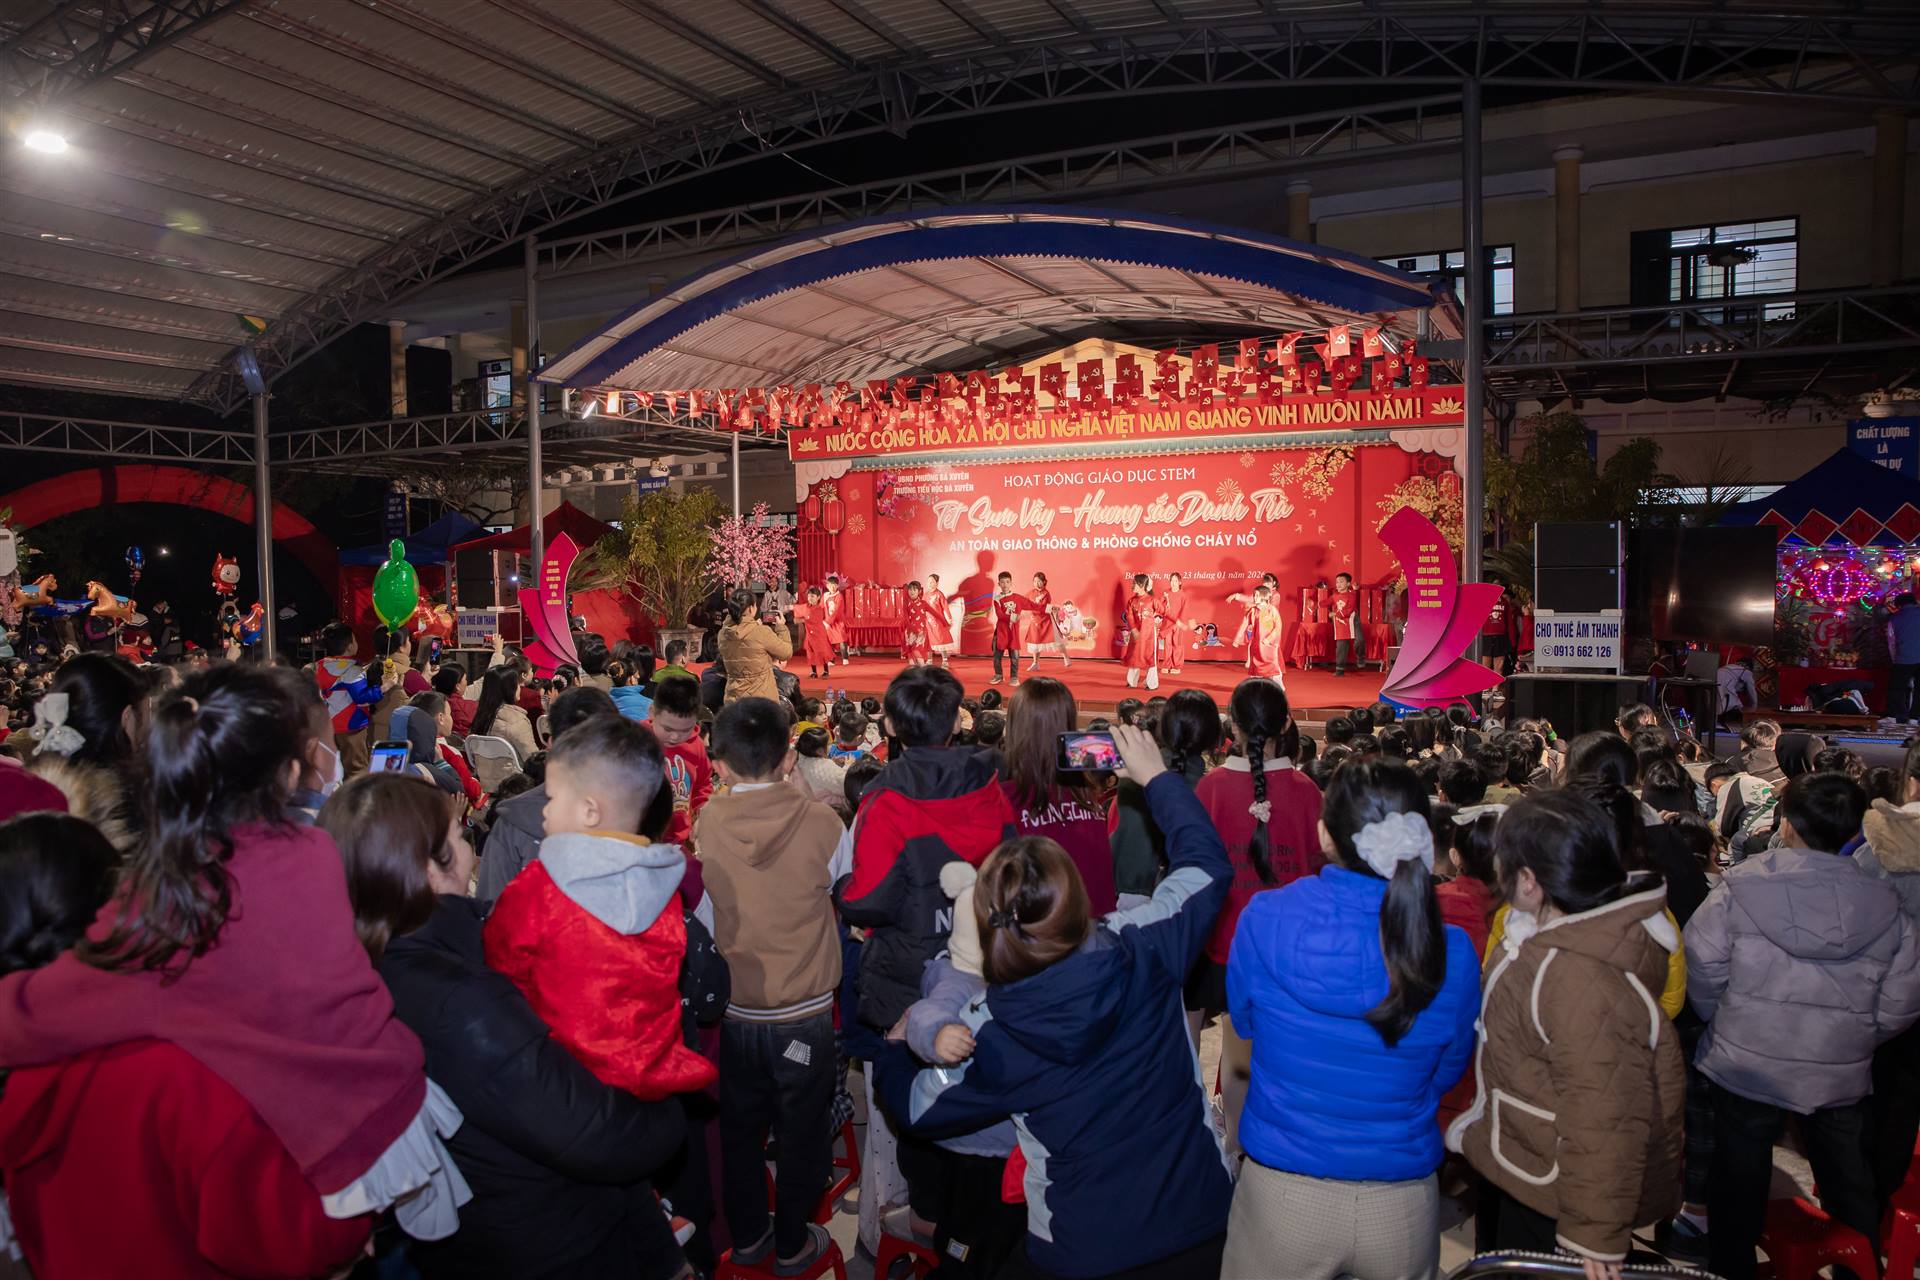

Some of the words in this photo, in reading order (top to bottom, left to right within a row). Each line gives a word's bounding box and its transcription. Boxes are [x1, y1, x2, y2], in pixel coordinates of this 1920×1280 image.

[825, 427, 867, 452] NƯỚC
[869, 427, 916, 452] CỘNG
[982, 417, 1010, 445] HỘI
[1050, 411, 1103, 438] NGHĨA
[1104, 408, 1136, 438] VIỆT
[1139, 411, 1181, 434] NAM
[1185, 407, 1252, 431] QUANG
[1255, 403, 1299, 427] VINH
[1302, 398, 1362, 424] MUÔN
[1366, 393, 1423, 420] NĂM!
[1856, 425, 1879, 439] CHẤT
[1881, 426, 1910, 440] LƯỢNG
[1878, 441, 1889, 454] LÀ
[1004, 474, 1041, 490] HOẠT
[1044, 470, 1084, 488] ĐỘNG
[1088, 468, 1124, 484] GIÁO
[1127, 468, 1157, 483] DỤC
[1160, 467, 1196, 481] STEM
[950, 540, 965, 550] AN
[968, 536, 999, 550] TOÀN
[1002, 538, 1033, 550] GIAO
[1035, 534, 1078, 550] THÔNG
[1081, 538, 1090, 549] &
[1093, 534, 1139, 549] PHÒNG
[1142, 530, 1192, 548] CHỐNG
[1195, 532, 1233, 547] CHÁY
[1236, 527, 1258, 547] NỔ
[1183, 571, 1192, 579] 23
[1193, 570, 1215, 582] tháng
[1216, 570, 1226, 578] 01
[1228, 570, 1244, 579] năm
[1535, 622, 1552, 638] CHO
[1554, 620, 1574, 638] THUÊ
[1576, 620, 1590, 638] ÂM
[1591, 623, 1619, 638] THANH
[1553, 645, 1575, 657] 0913
[1577, 646, 1593, 657] 662
[1595, 646, 1612, 658] 126
